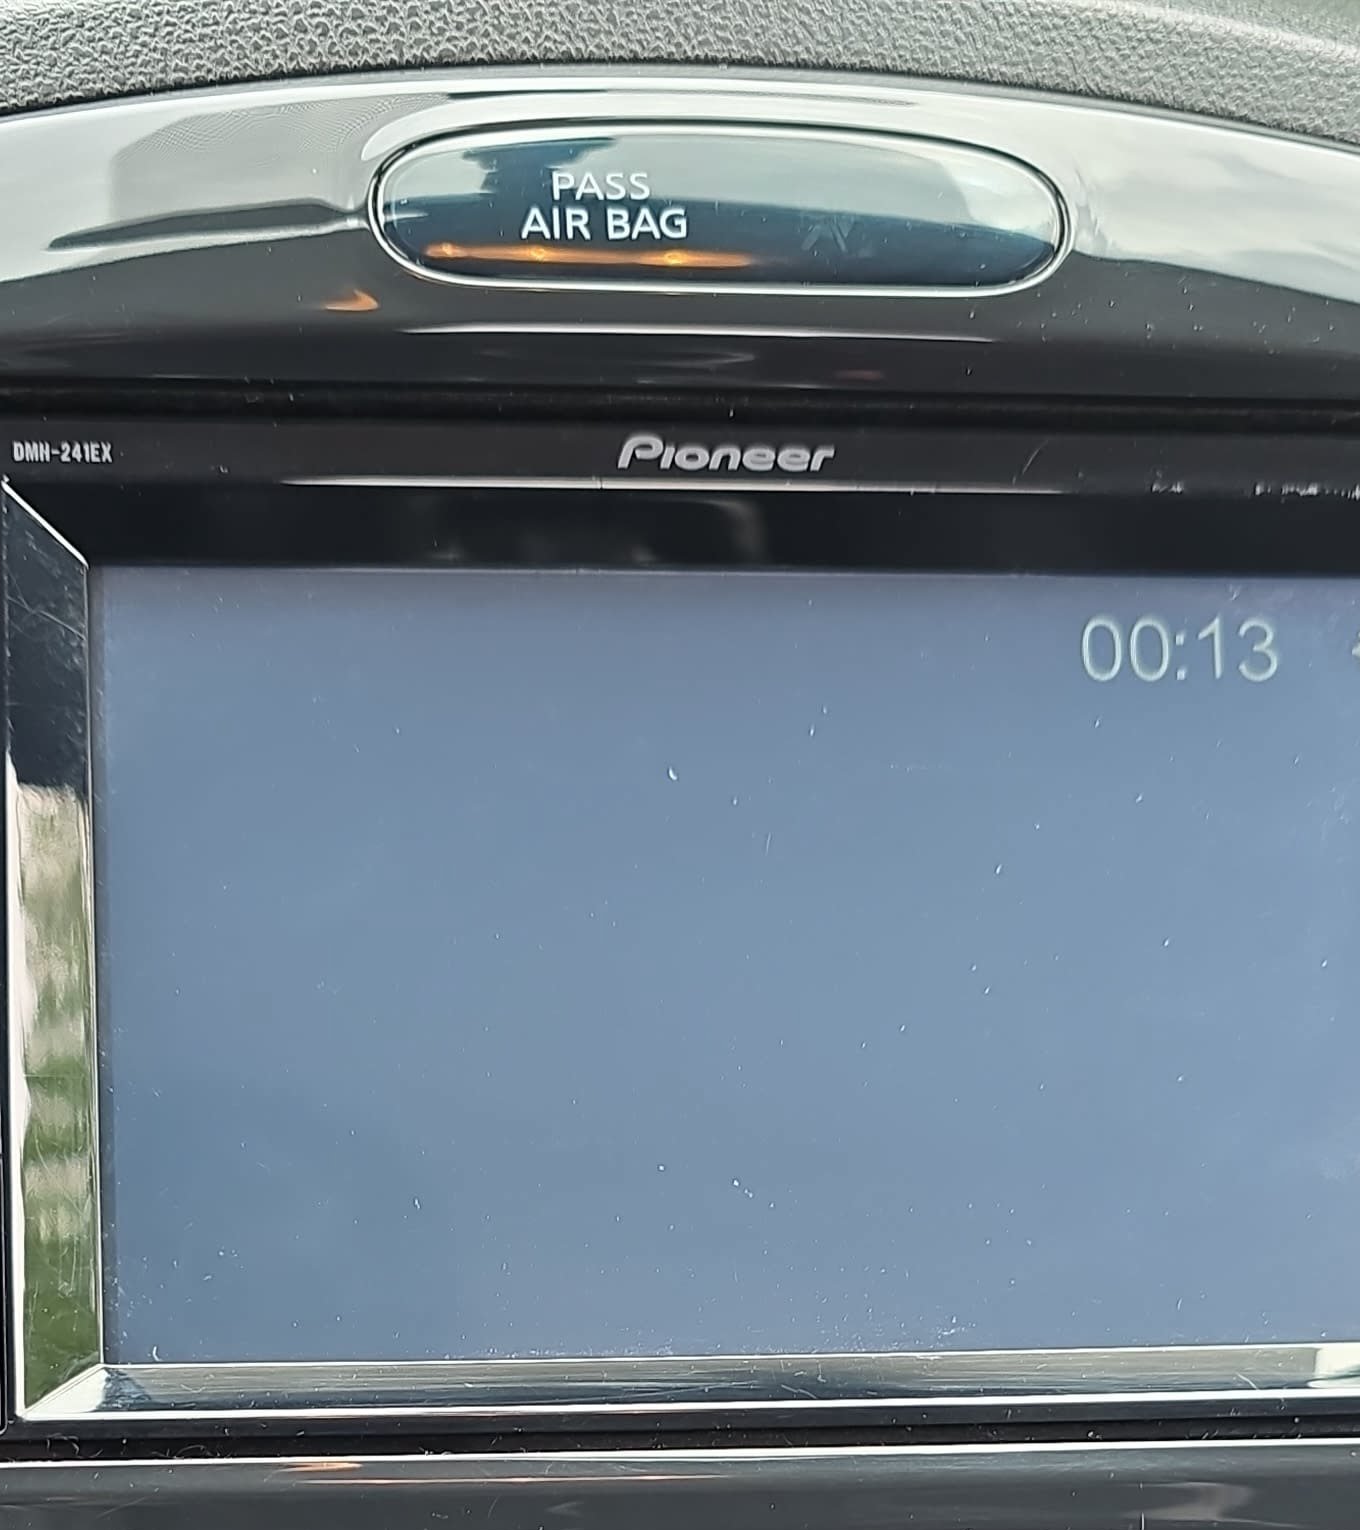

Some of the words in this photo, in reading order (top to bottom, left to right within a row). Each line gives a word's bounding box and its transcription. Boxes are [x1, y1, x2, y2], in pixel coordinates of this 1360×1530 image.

[551, 170, 650, 200] PASS
[521, 207, 592, 239] AIR
[606, 206, 689, 239] BAG
[12, 441, 113, 463] DMH-241EX
[617, 433, 835, 472] Pioneer
[1081, 614, 1279, 682] 00:13
